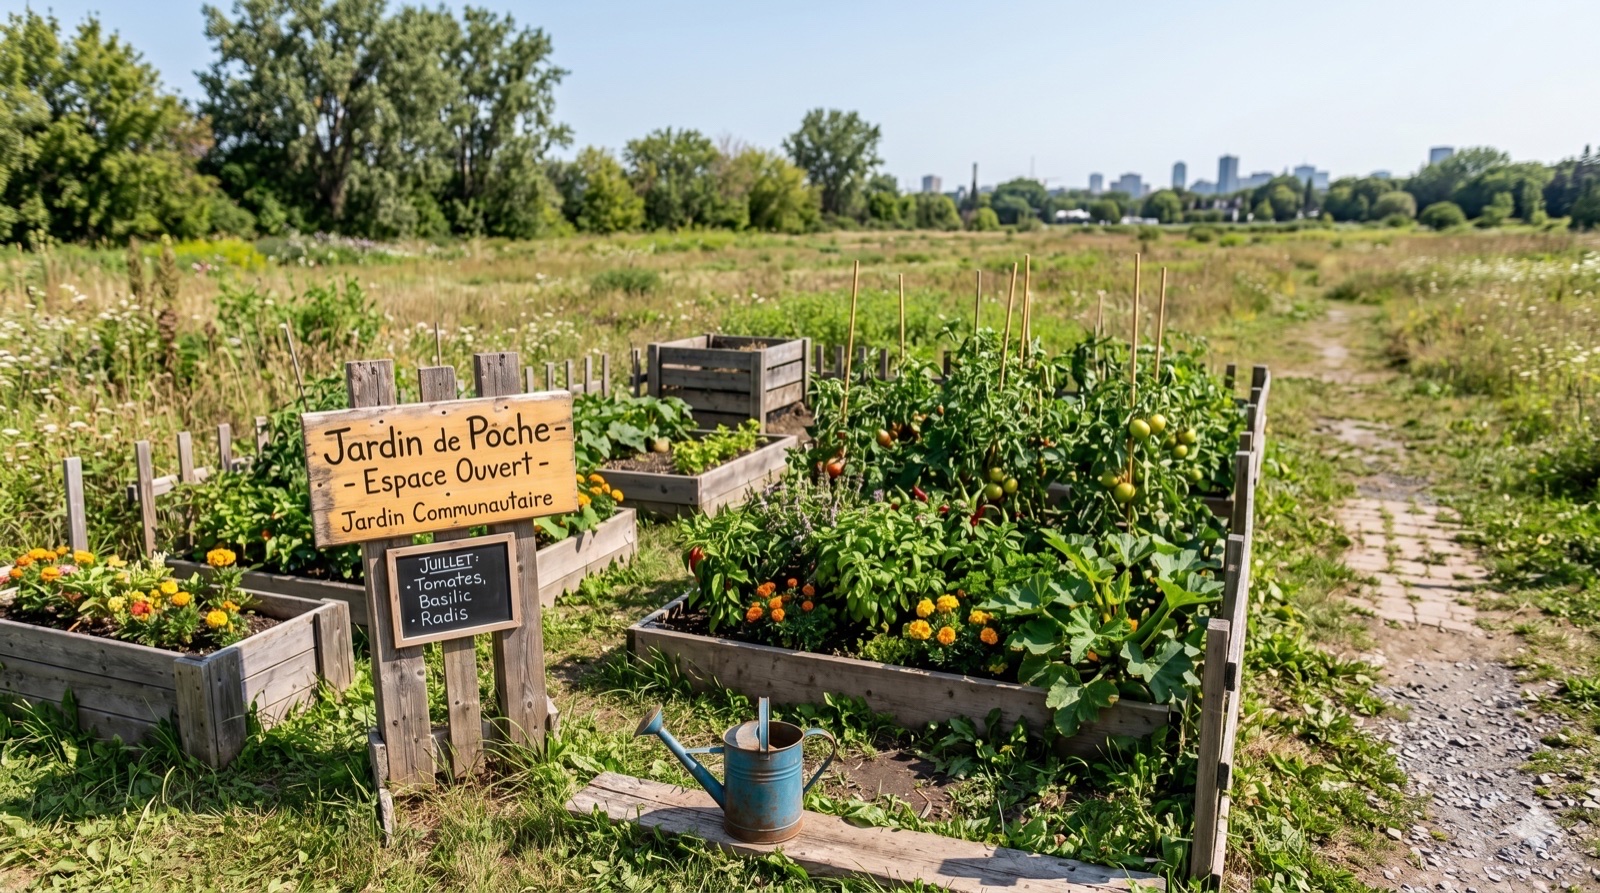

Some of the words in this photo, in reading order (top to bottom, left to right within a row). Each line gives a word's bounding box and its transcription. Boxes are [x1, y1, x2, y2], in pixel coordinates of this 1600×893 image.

[323, 426, 423, 466] Jardin
[433, 427, 461, 453] de
[363, 467, 447, 498] Espace
[456, 452, 533, 482] Ouvert
[341, 508, 405, 533] Jardin
[413, 491, 553, 523] Communautaire
[414, 572, 486, 591] Tomates,
[419, 590, 472, 609] Basilic
[421, 607, 468, 627] Radis
